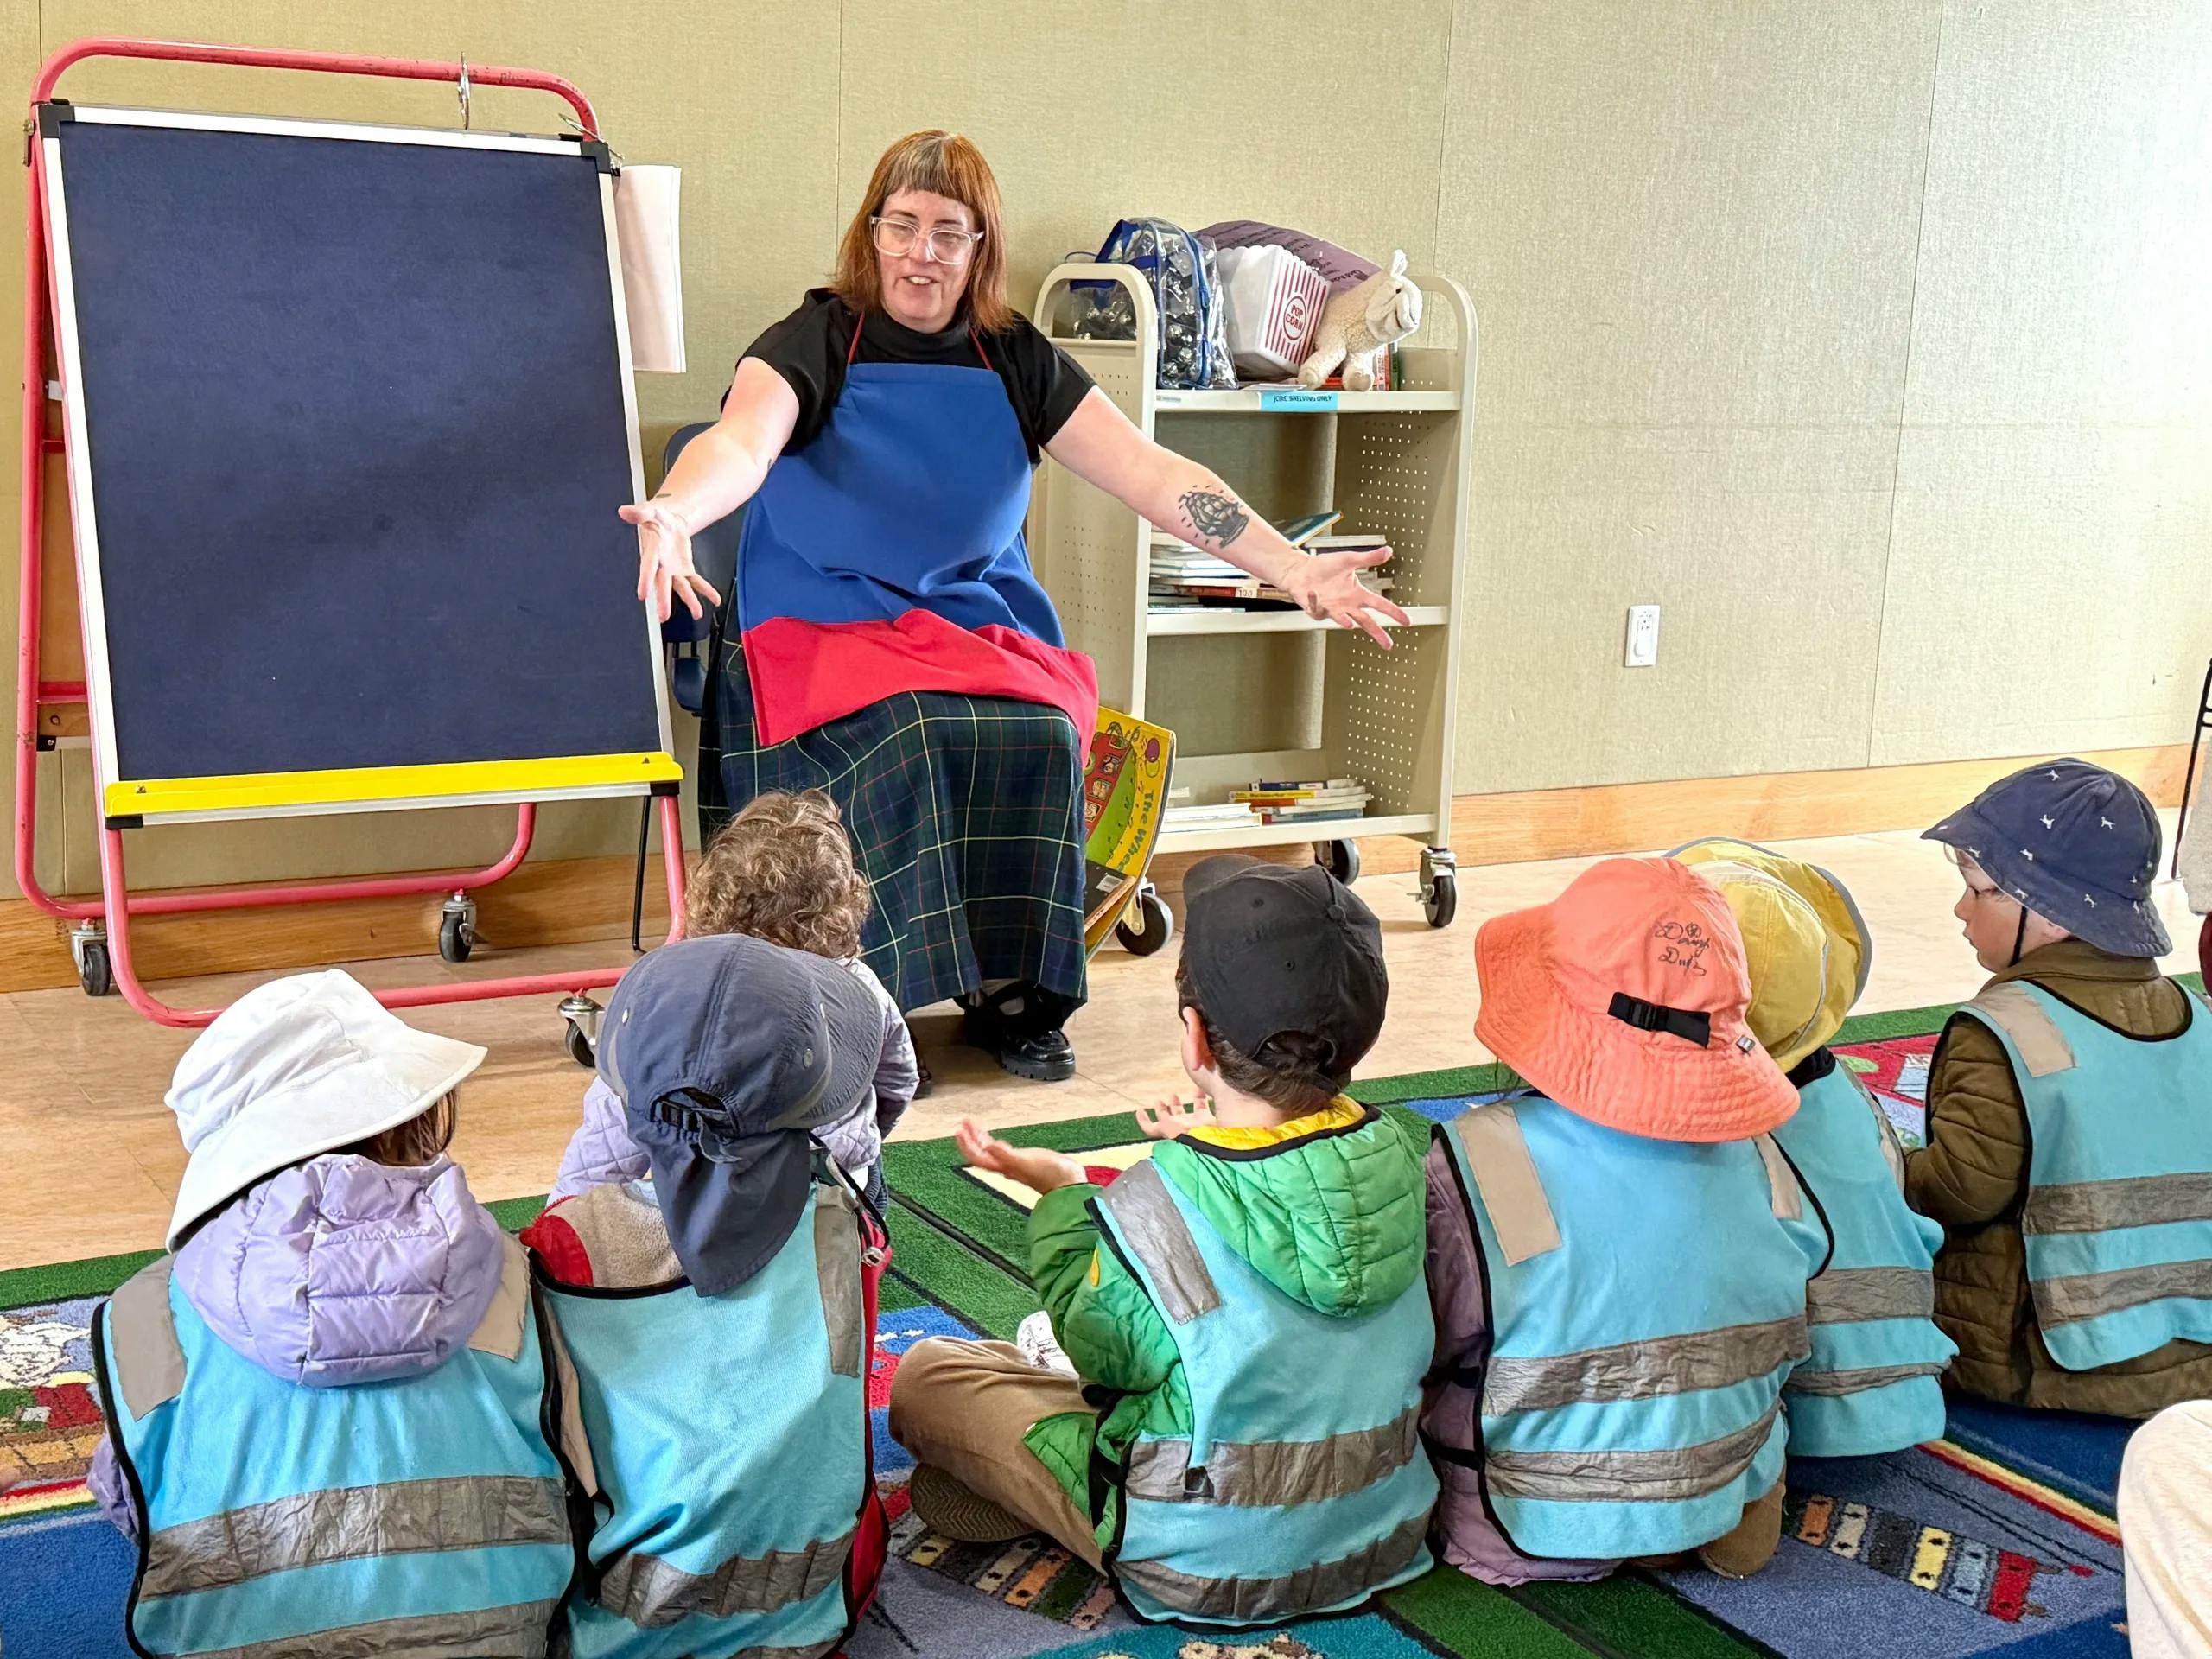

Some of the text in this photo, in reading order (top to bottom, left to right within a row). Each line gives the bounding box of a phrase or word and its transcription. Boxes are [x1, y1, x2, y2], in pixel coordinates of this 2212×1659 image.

[1291, 304, 1303, 318] POP
[1286, 313, 1303, 331] CORN
[1141, 790, 1154, 824] The
